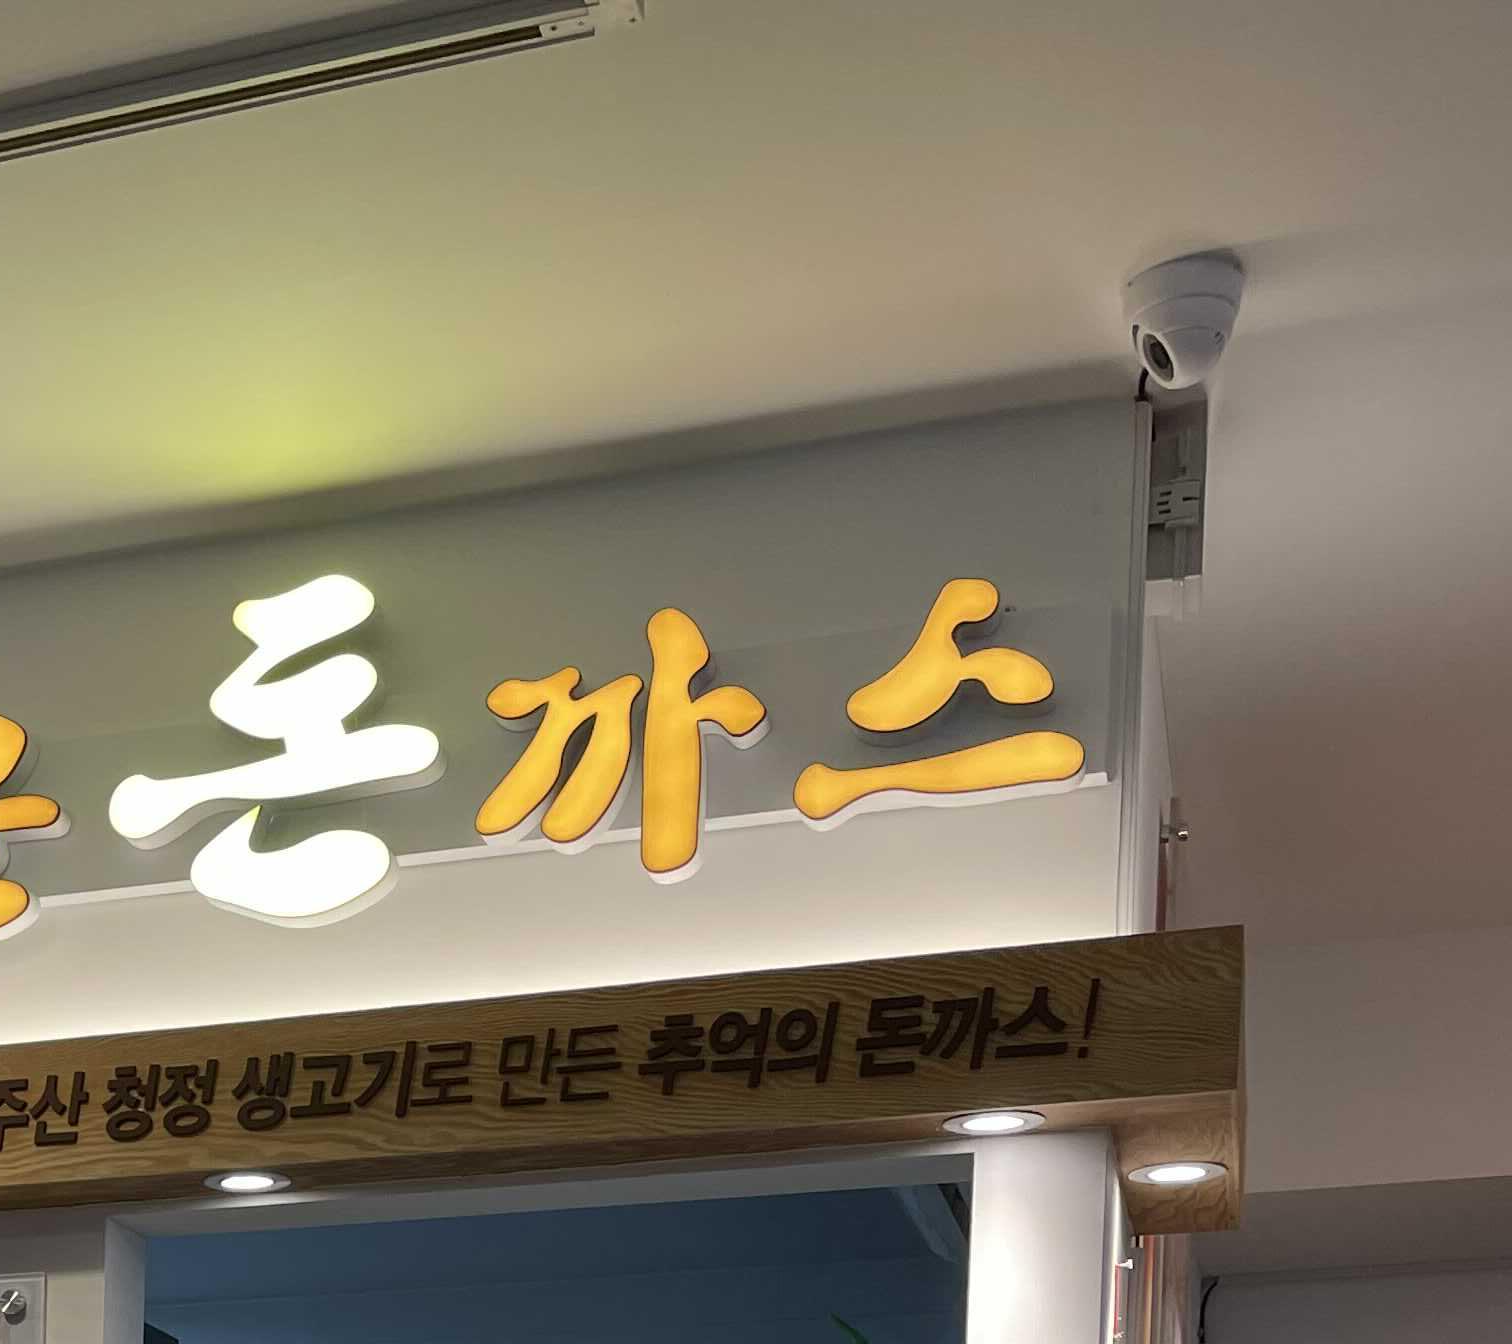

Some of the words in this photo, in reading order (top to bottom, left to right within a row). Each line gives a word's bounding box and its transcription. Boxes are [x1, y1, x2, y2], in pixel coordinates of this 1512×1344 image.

[101, 1065, 218, 1143] 청정
[231, 1039, 475, 1135] 생고기로
[497, 1023, 622, 1110] 만든
[638, 1002, 838, 1094] 추억의
[856, 976, 1102, 1074] 돈까스!
